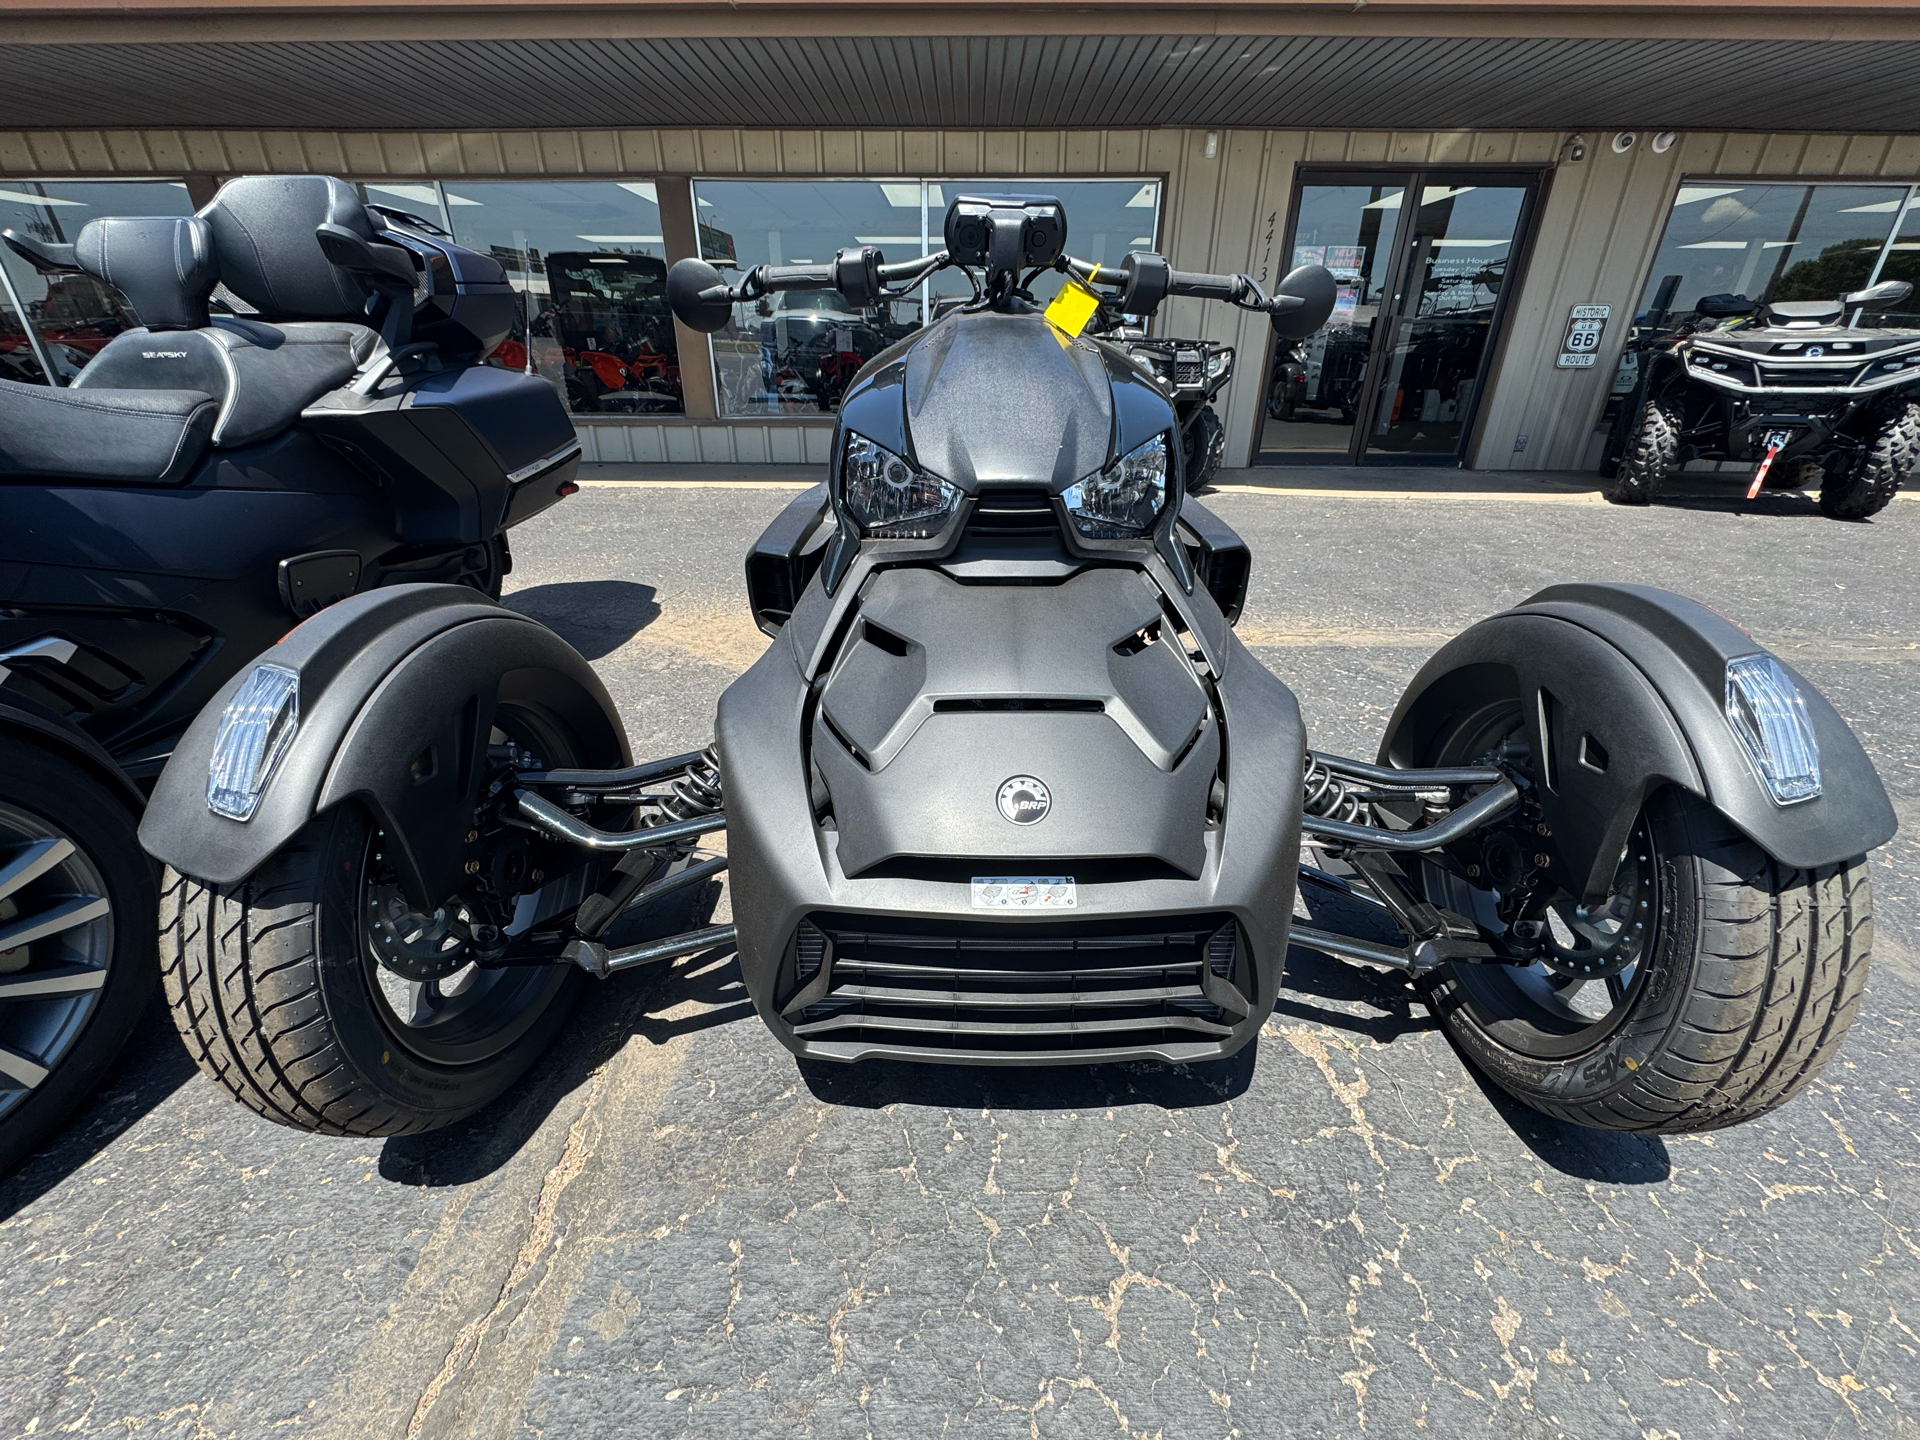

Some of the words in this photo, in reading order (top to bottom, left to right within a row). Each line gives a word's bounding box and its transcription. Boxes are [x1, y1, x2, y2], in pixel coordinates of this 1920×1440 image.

[1258, 211, 1277, 283] 4413
[1335, 249, 1357, 257] HELP
[1327, 259, 1361, 267] WANTED
[1575, 307, 1607, 317] HISTORIC
[1571, 332, 1596, 347] 66
[1564, 355, 1591, 365] ROUTE
[1019, 800, 1047, 810] BRP
